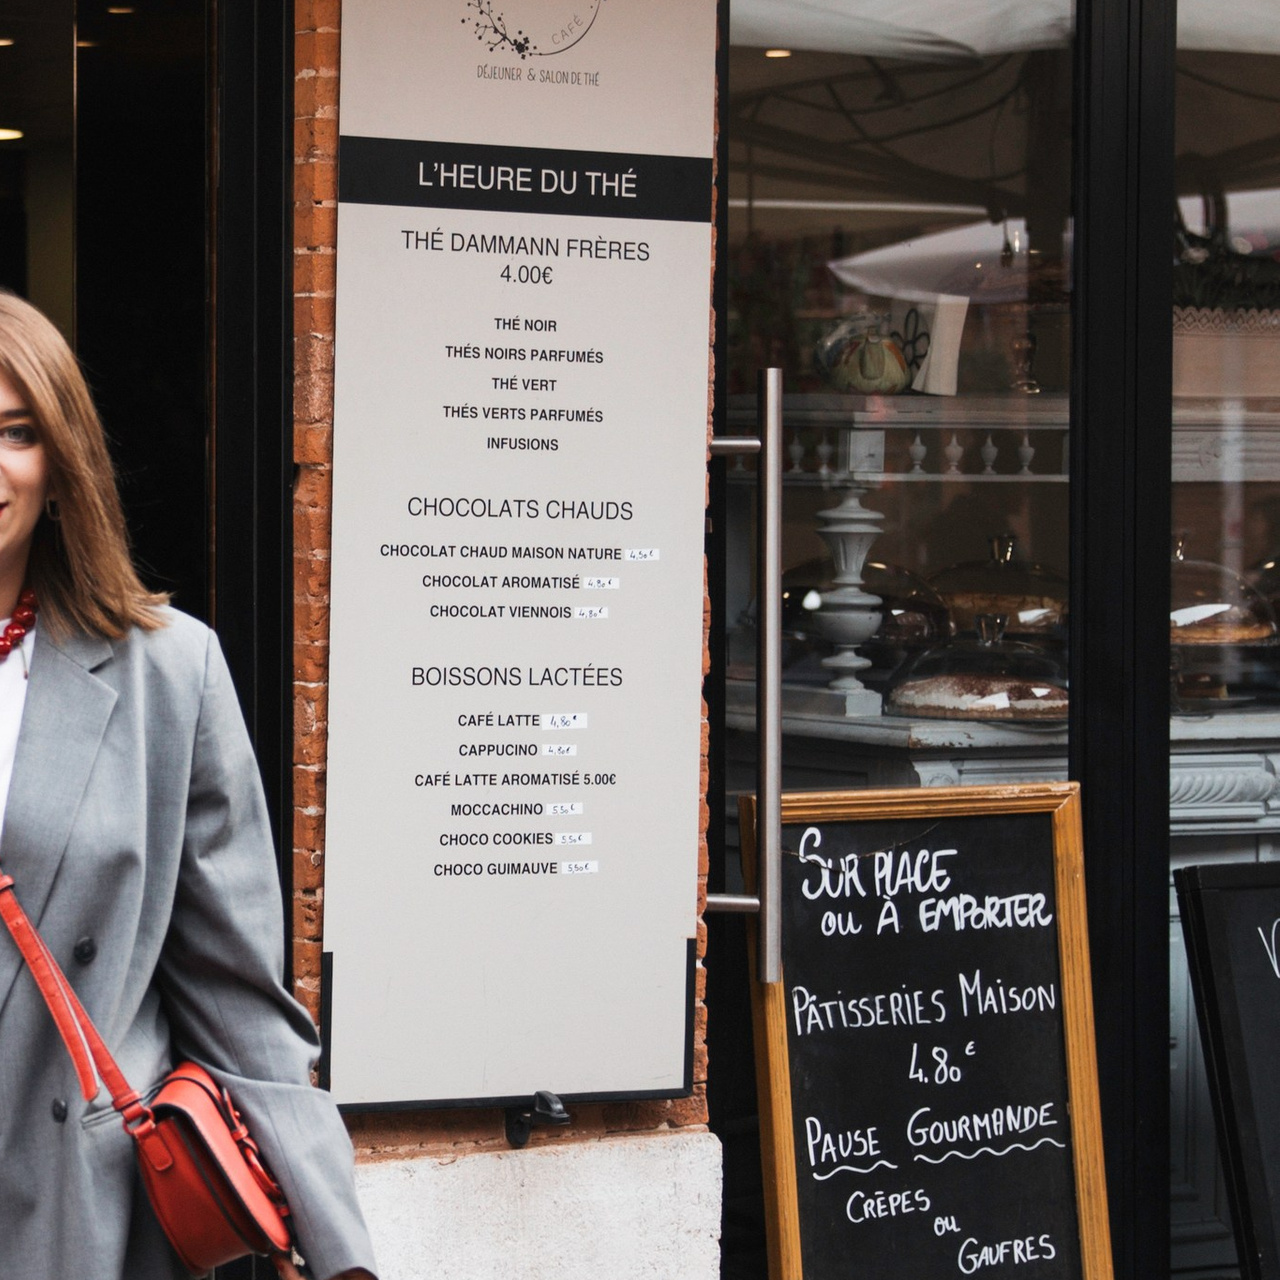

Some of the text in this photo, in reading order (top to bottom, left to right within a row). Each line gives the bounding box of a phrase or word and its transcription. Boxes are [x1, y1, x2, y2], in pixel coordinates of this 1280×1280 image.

[551, 14, 584, 45] CAFÉ
[477, 64, 599, 86] DÉJEUNER & SALON DE THÉ
[418, 162, 637, 197] L'HEURE DU THÉ
[402, 228, 650, 261] THÉ DAMMANN FRÈRES
[500, 265, 553, 285] 4.00€
[494, 316, 557, 332] THÉ NOIR
[445, 344, 604, 363] THÉS NOIRS PARFUMÉS
[492, 376, 557, 391] THÉ VERT
[443, 404, 603, 423] THÉS VERTS PARFUMÉS
[487, 437, 559, 451] INFUSIONS
[407, 497, 634, 520] CHOCOLATS CHAUDS
[380, 544, 622, 560] CHOCOLAT CHAUD MAISON NATURE
[422, 574, 580, 589] CHOCOLAT AROMATISÉ
[430, 605, 572, 618] CHOCOLAT VIENNOIS
[412, 663, 623, 687] BOISSONS LACTÉES
[458, 712, 540, 727] CAFÉ LATTE
[459, 744, 538, 757] CAPPUCINO
[414, 770, 617, 787] CAFÉ LATTE AROMATISÉ 5.00€
[451, 803, 543, 816] MOCCACHINO
[439, 833, 553, 847] CHOCO COOKIES
[433, 862, 558, 877] CHOCO GUIMAUVE
[798, 826, 958, 900] SUR PLACE
[877, 895, 900, 935] À
[919, 893, 1053, 932] EMPORTER
[805, 1102, 1058, 1167] PAUSE GOURMANDE
[958, 1234, 1056, 1274] GAUFRES
